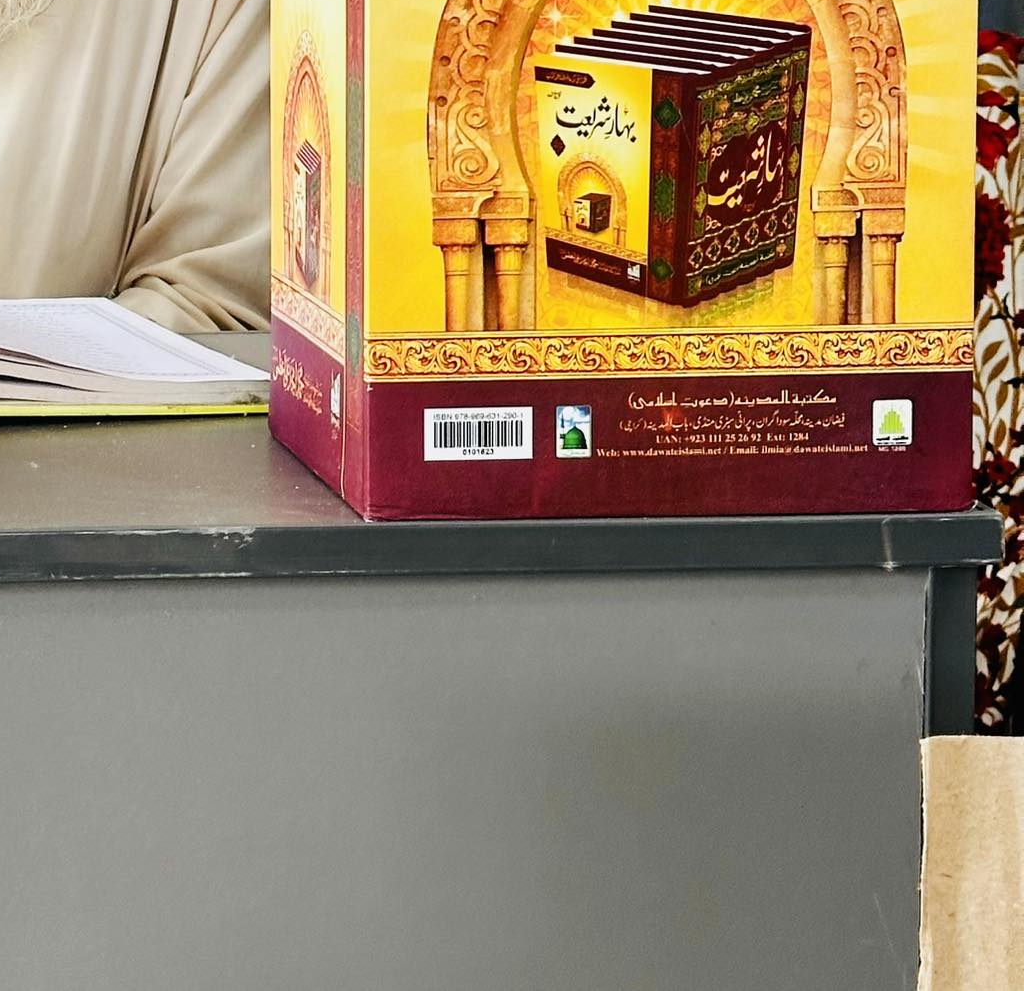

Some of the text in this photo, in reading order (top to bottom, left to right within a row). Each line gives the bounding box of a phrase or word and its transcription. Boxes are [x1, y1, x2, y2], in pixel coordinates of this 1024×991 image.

[555, 95, 611, 140] شریعت
[656, 432, 809, 444] UAN: +923 111 25 26 92 Ext: 1284
[596, 447, 621, 457] Web:
[623, 445, 722, 457] www.dawateislami.net
[729, 445, 760, 455] Email:
[761, 443, 869, 456] ilmia@dawateislami.net
